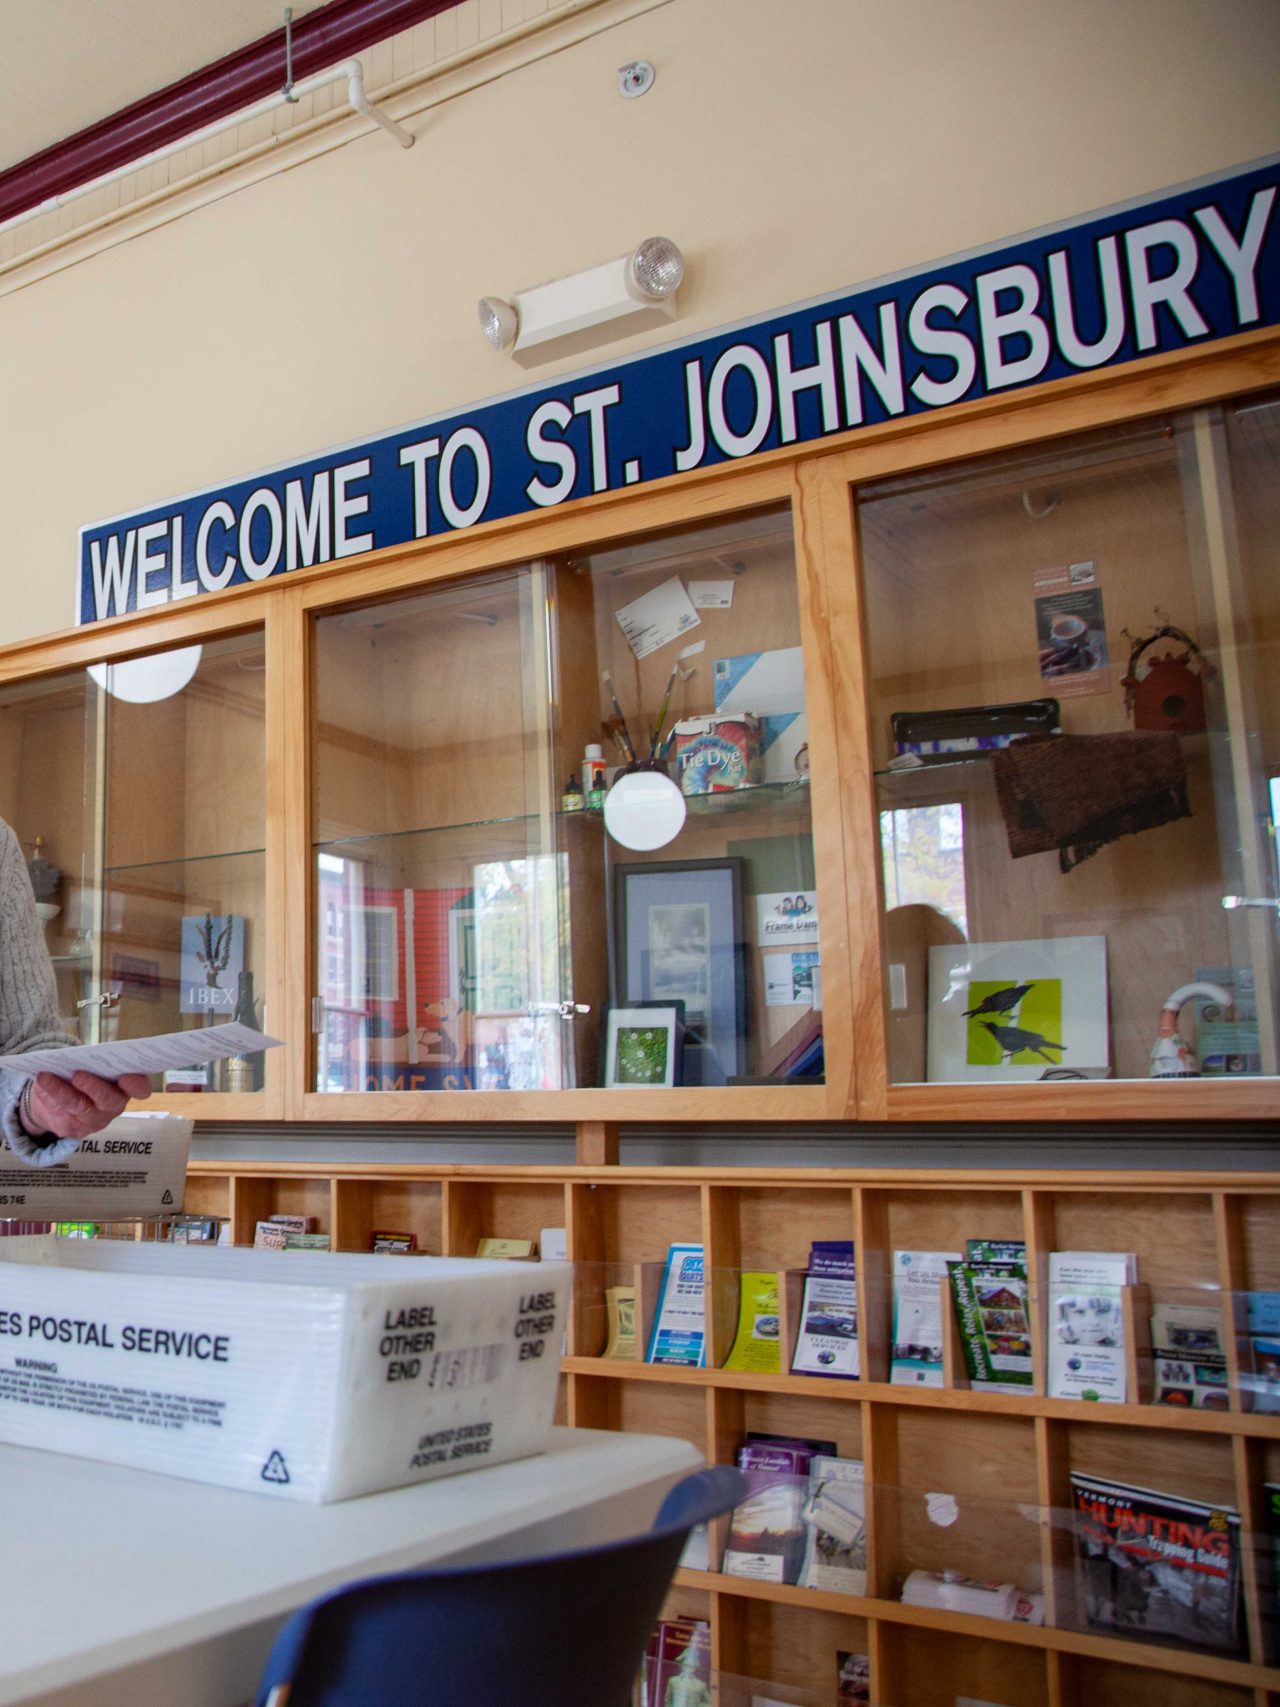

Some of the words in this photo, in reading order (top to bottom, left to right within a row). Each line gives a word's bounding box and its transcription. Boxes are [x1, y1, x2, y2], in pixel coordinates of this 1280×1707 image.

[89, 457, 375, 622] WELCOME
[399, 427, 491, 538] TO
[525, 384, 640, 507] ST.
[675, 185, 1278, 473] JOHNSBURY
[679, 753, 705, 770] Tie
[707, 748, 741, 772] Dye
[188, 987, 236, 1005] IBEX
[103, 1140, 153, 1155] SERVICE
[9, 1195, 26, 1205] 74E
[519, 1291, 557, 1314] LABEL
[384, 1306, 437, 1331] LABEL
[514, 1314, 555, 1338] OTHER
[28, 1315, 115, 1349] POSTAL
[121, 1326, 230, 1363] SERVICE
[379, 1331, 436, 1357] OTHER
[518, 1339, 546, 1361] END
[14, 1356, 58, 1374] WARNING
[386, 1359, 421, 1382] END
[418, 1429, 455, 1450] UNITED
[455, 1421, 494, 1442] STATES
[409, 1449, 448, 1469] POSTAL
[449, 1438, 494, 1460] SERVICE
[1076, 1488, 1132, 1509] VERMONT
[1079, 1498, 1230, 1558] HUNTING
